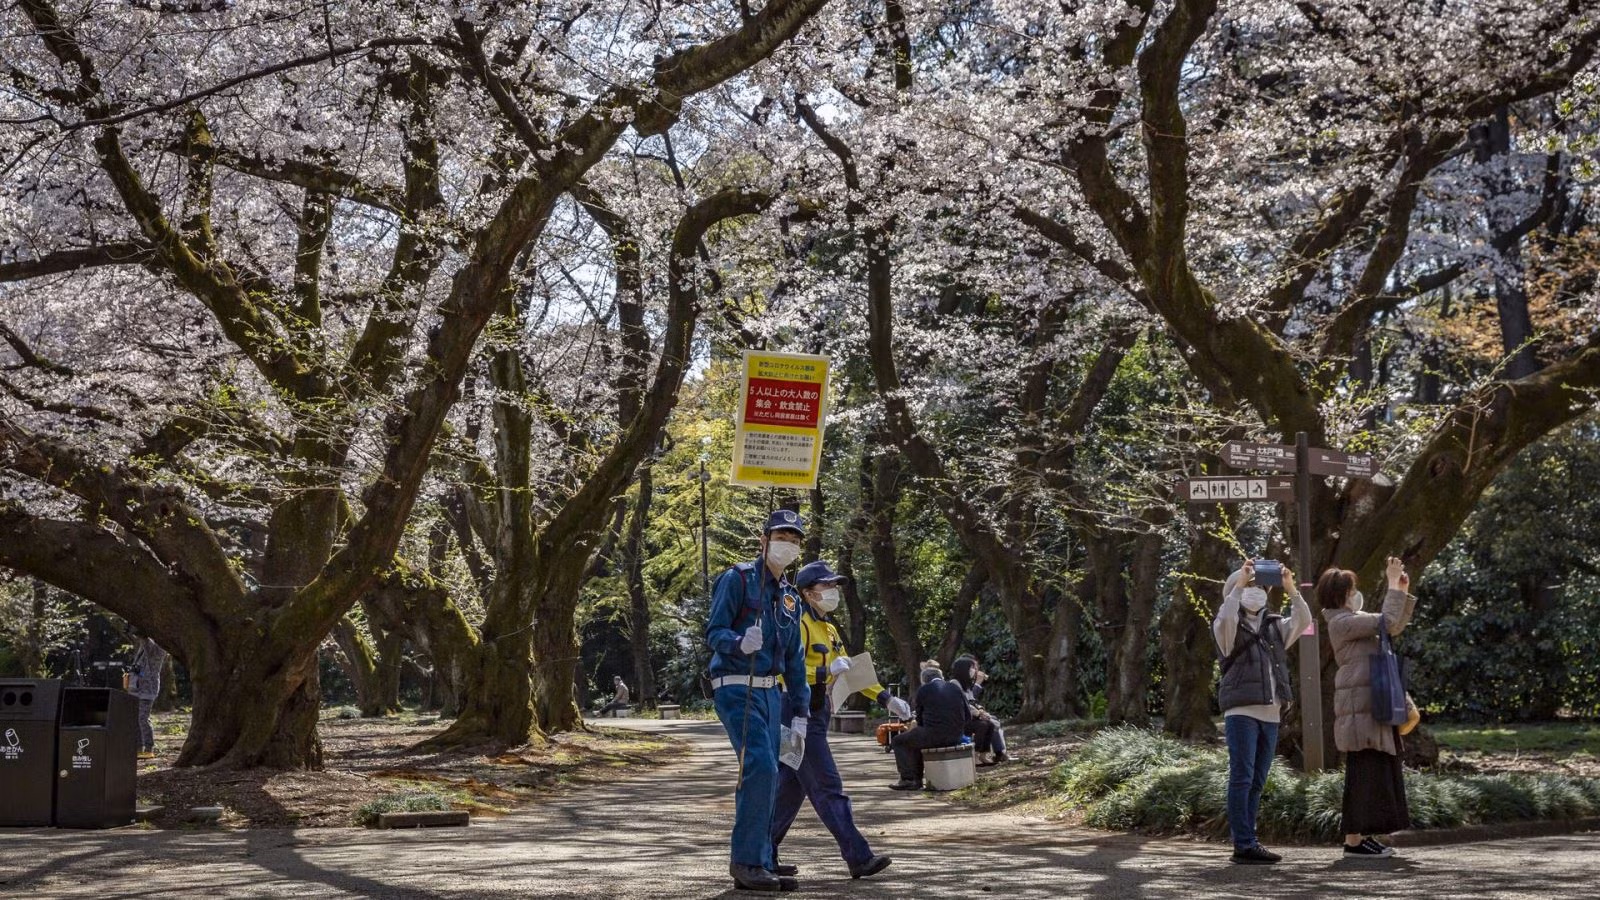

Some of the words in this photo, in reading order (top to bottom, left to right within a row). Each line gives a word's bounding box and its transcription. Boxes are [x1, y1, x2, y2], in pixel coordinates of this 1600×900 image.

[755, 398, 811, 412] 集会・飲食禁止
